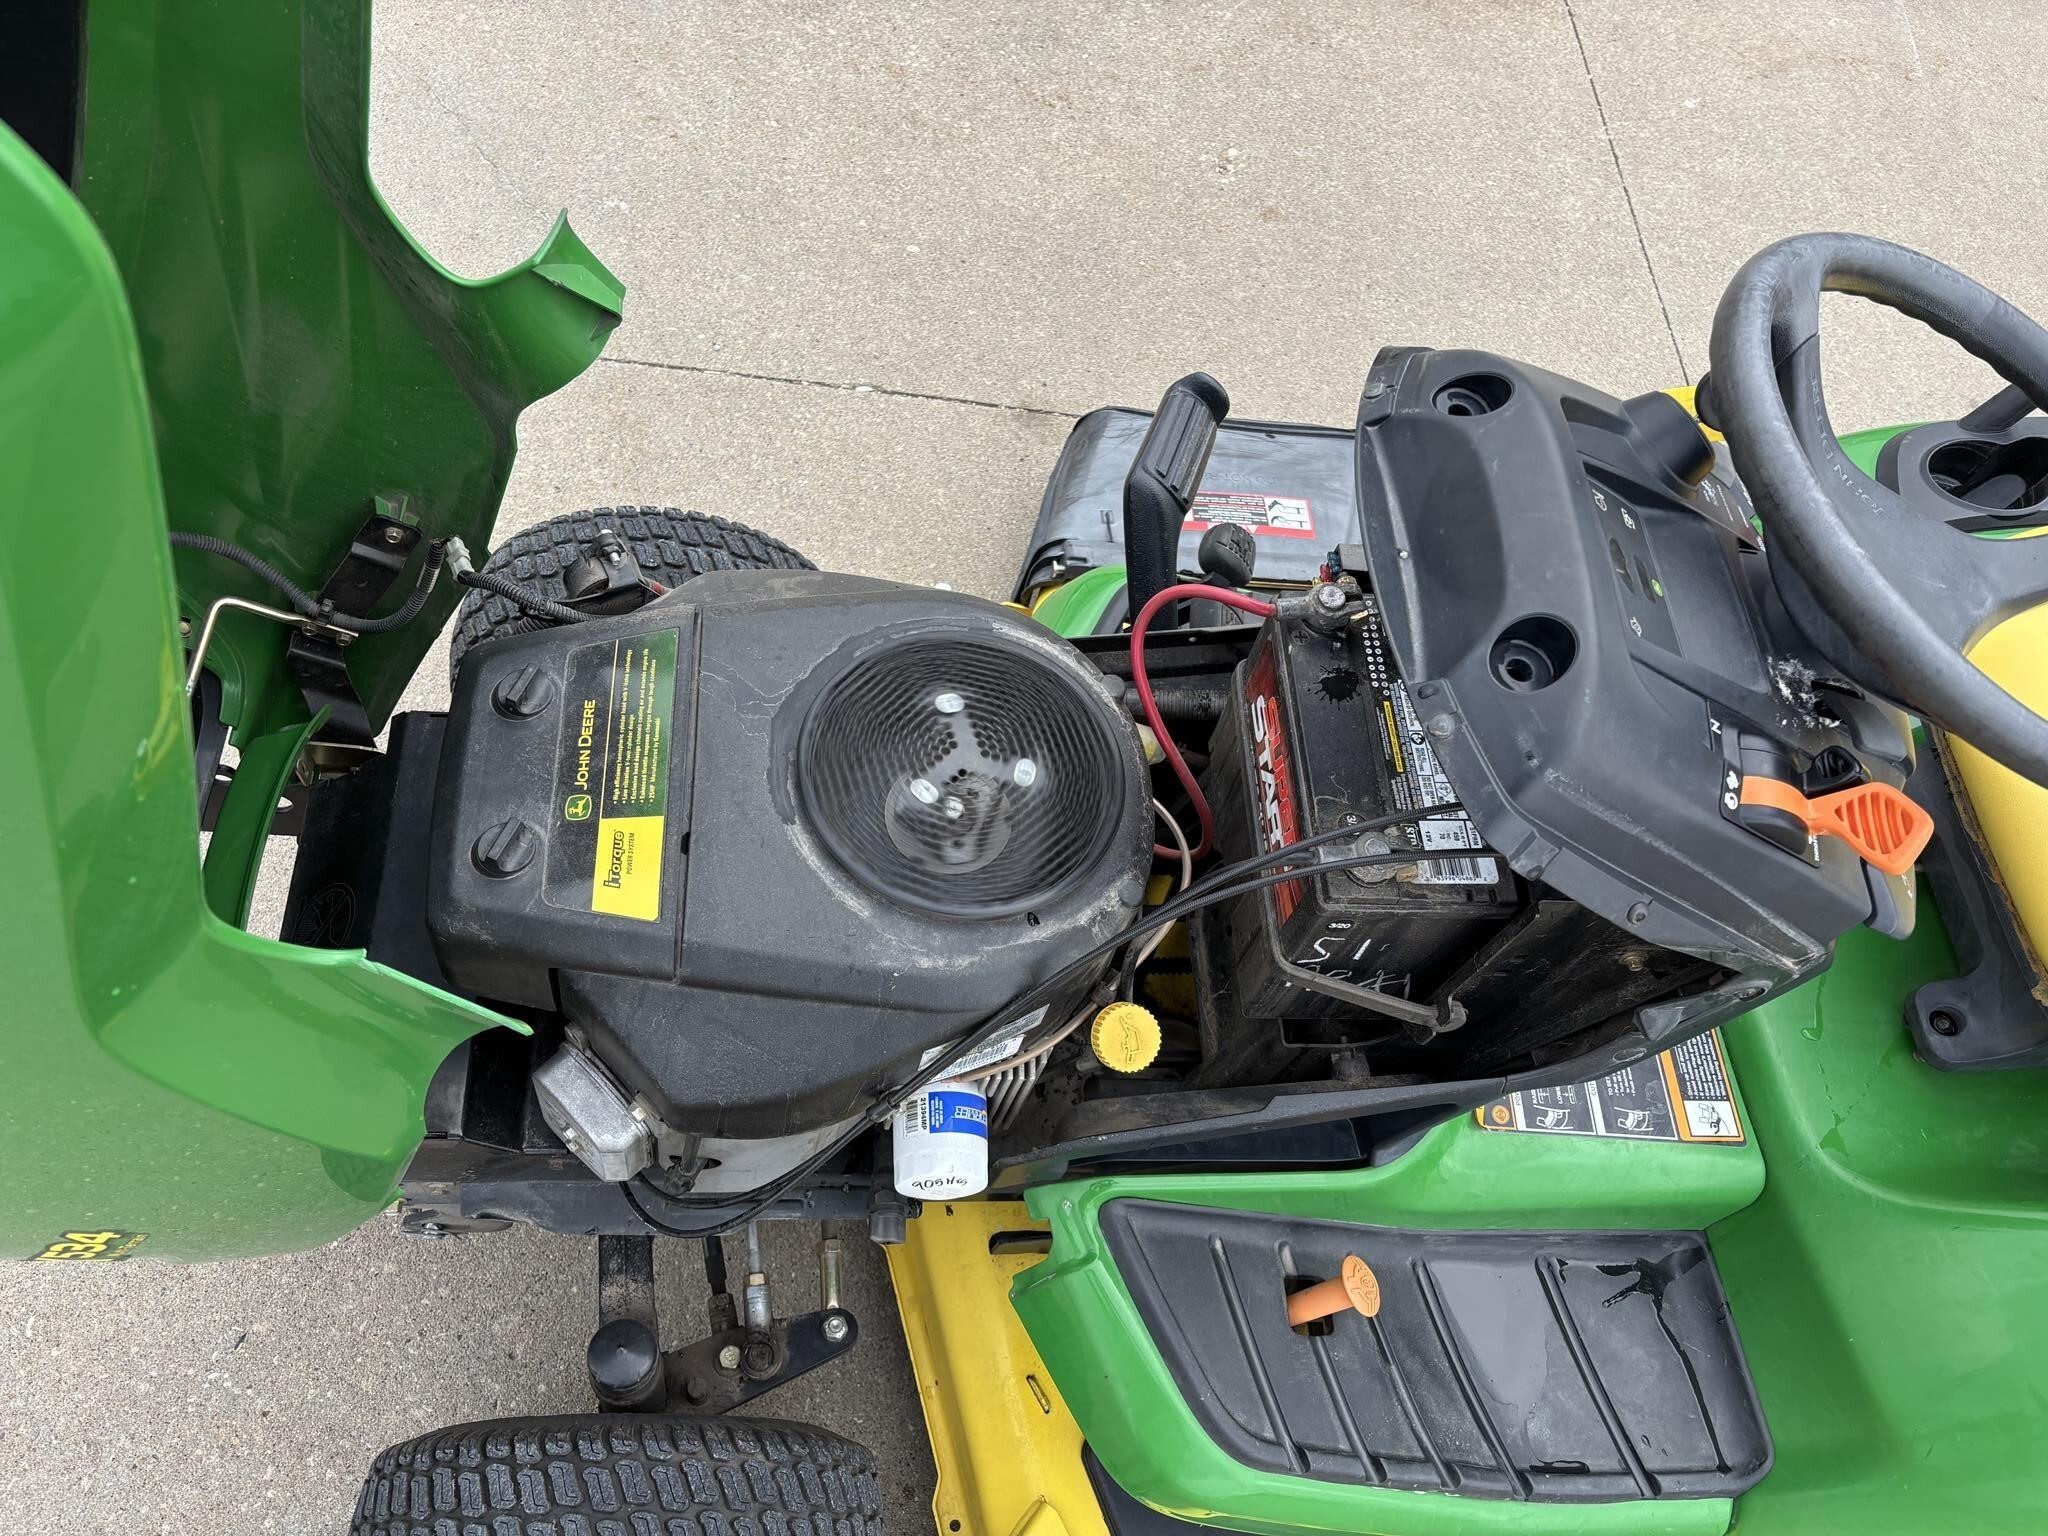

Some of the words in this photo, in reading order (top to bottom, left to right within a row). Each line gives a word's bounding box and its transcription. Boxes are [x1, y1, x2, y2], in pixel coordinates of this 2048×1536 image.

[625, 648, 633, 673] technology
[580, 699, 597, 745] DEERE
[573, 746, 590, 791] JOHN
[1251, 694, 1285, 851] STAR
[639, 774, 647, 799] Enhanced
[627, 832, 635, 855] SYSTEM
[1812, 834, 1820, 862] THROTT
[603, 830, 626, 889] iTorque
[625, 855, 633, 875] POWER
[1530, 1089, 1538, 1104] RAIS
[1555, 1086, 1563, 1104] LOWE
[920, 1097, 928, 1130] 21394MP
[35, 1231, 122, 1261] 534
